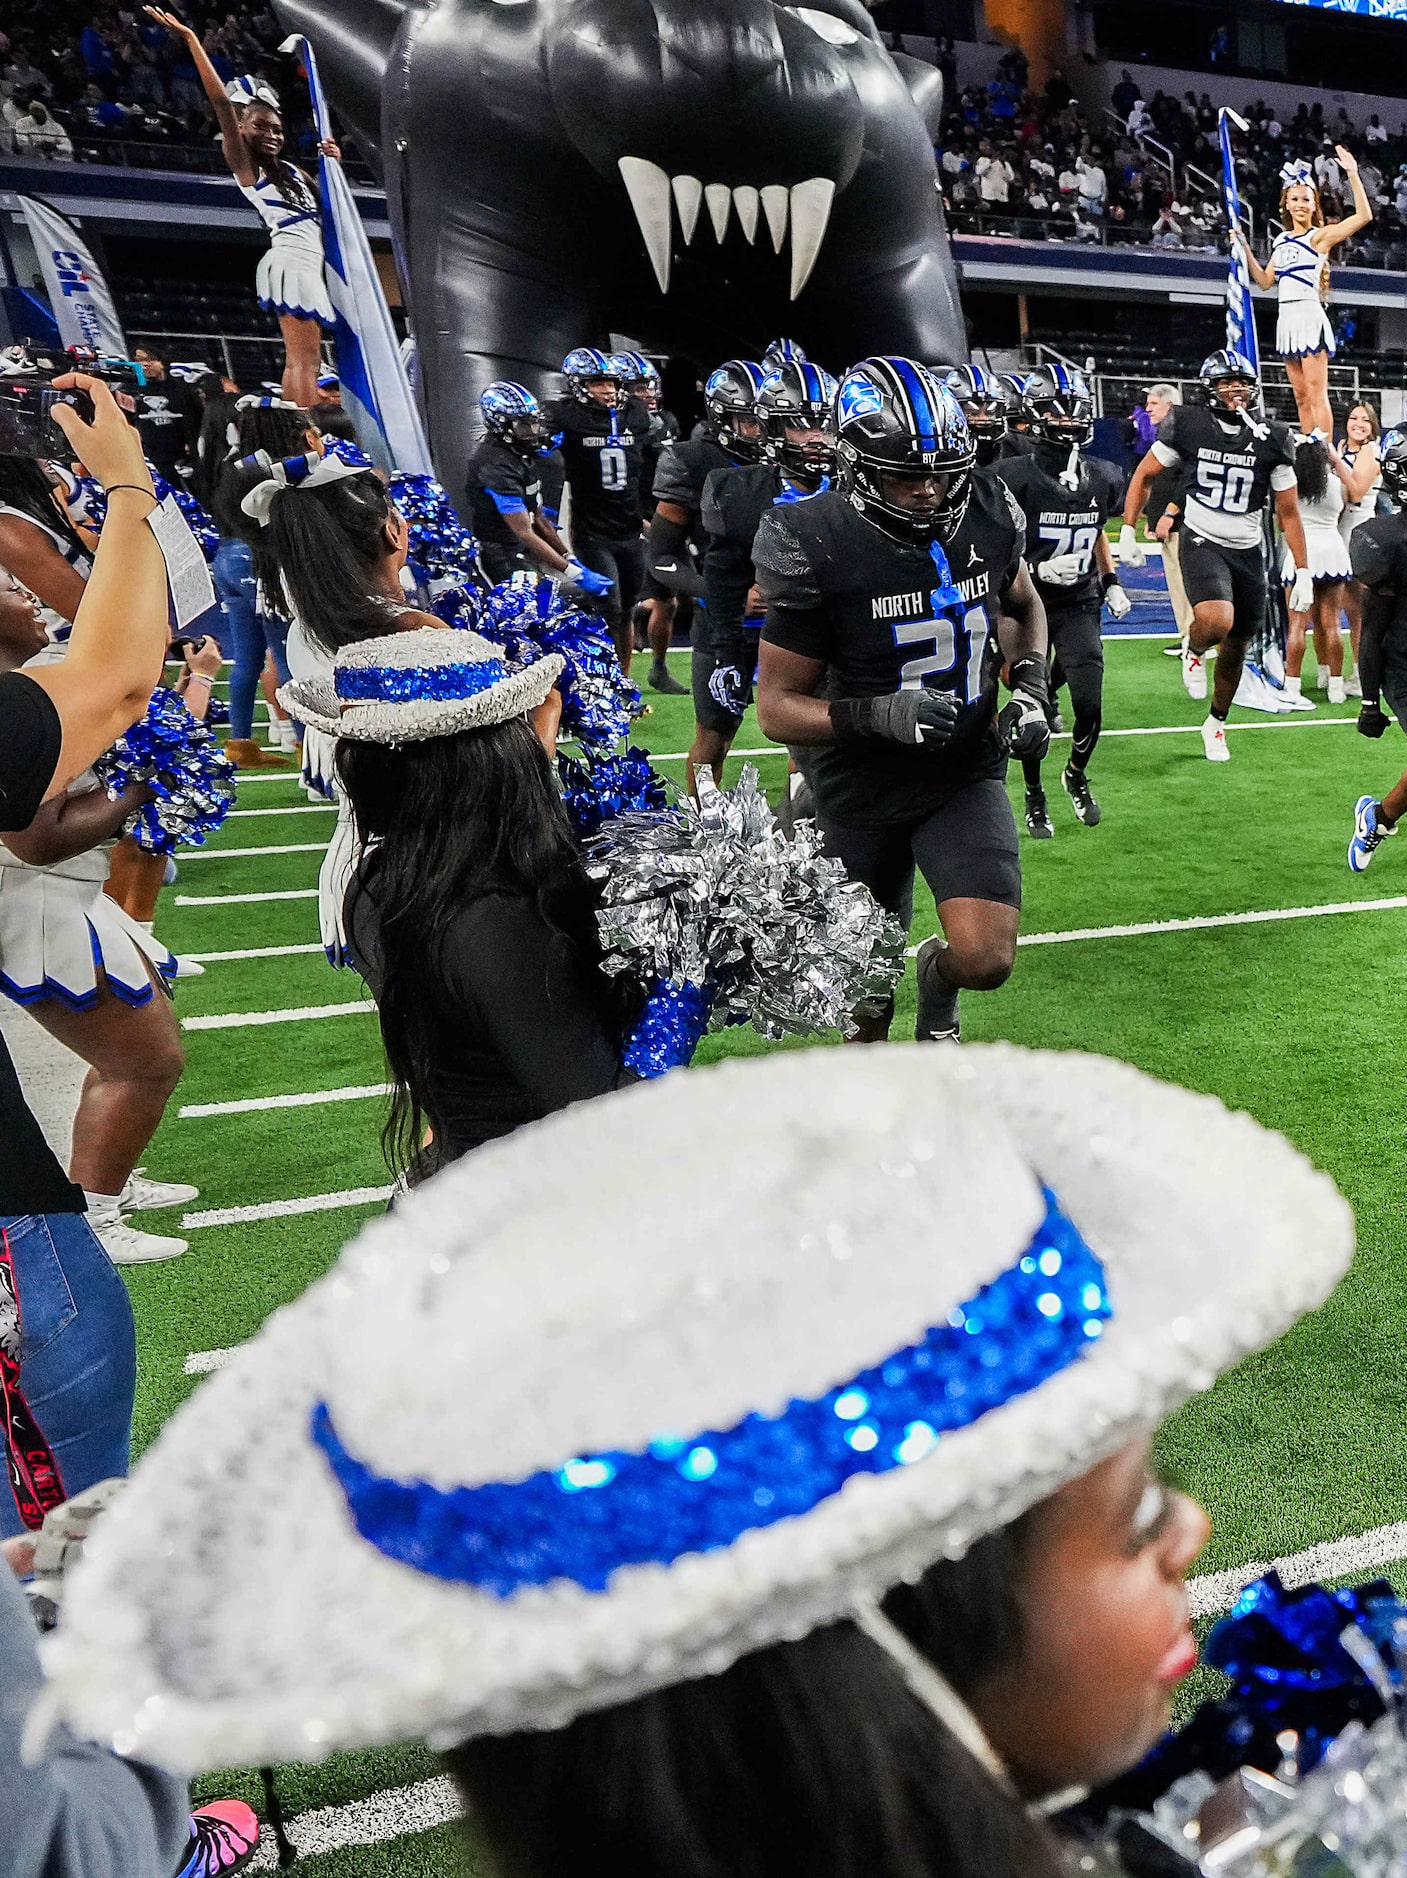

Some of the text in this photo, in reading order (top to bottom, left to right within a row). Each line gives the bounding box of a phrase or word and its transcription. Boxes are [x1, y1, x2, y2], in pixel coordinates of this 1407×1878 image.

[600, 447, 627, 491] 0
[922, 452, 937, 465] 817
[1195, 460, 1255, 514] 50
[1039, 511, 1099, 526] NORTH CROWLEY
[1038, 526, 1099, 576] 78
[871, 591, 924, 620] NORTH
[929, 570, 989, 611] WLEY
[891, 603, 990, 705] 21
